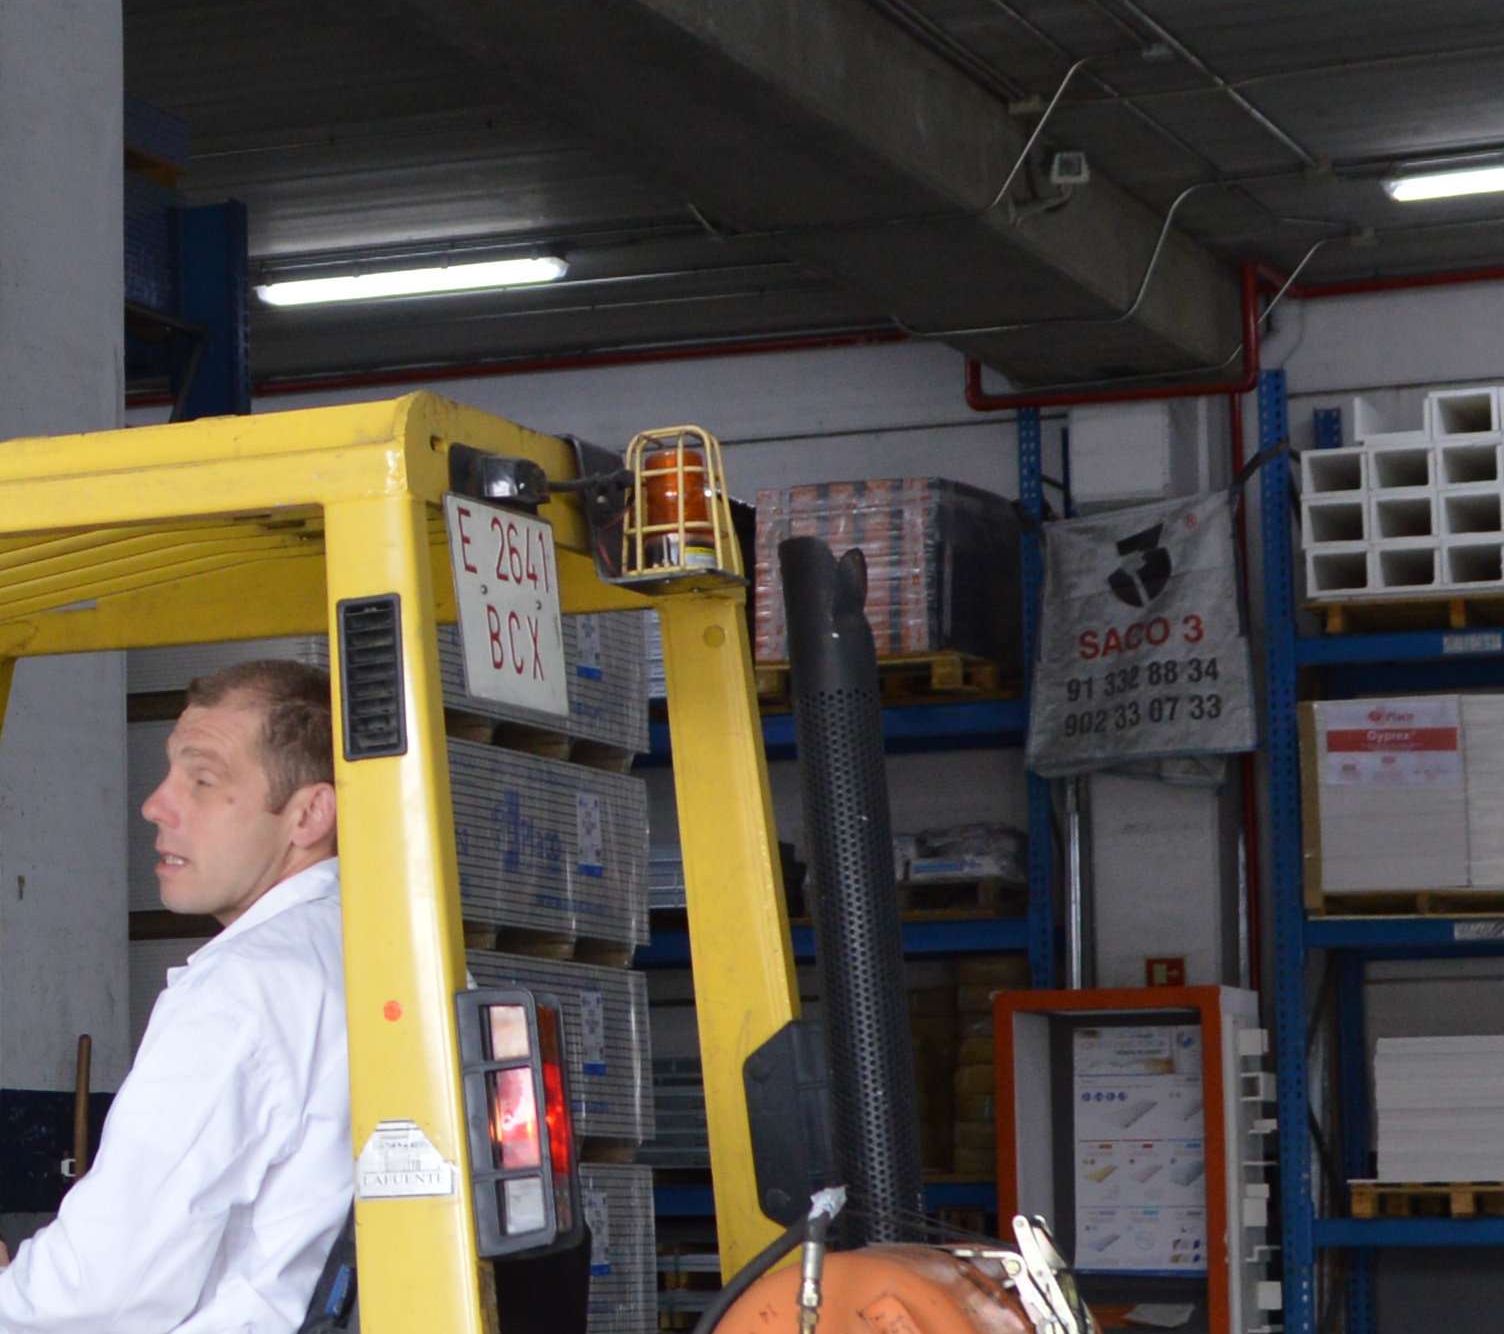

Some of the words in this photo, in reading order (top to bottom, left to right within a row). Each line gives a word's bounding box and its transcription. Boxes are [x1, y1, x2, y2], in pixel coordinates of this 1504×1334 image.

[455, 506, 477, 573] E
[494, 519, 552, 594] 2641
[486, 604, 545, 681] BCX
[1078, 619, 1171, 661] SACO
[1181, 613, 1206, 644] 3
[1066, 676, 1098, 704] 91
[1103, 668, 1141, 698] 332
[1147, 660, 1179, 687] 88
[1185, 656, 1220, 684] 34
[1064, 708, 1107, 738] 902
[1113, 701, 1142, 730] 33
[1147, 696, 1179, 726] 07
[1188, 693, 1222, 722] 33
[363, 1172, 444, 1187] LAFUENTE
